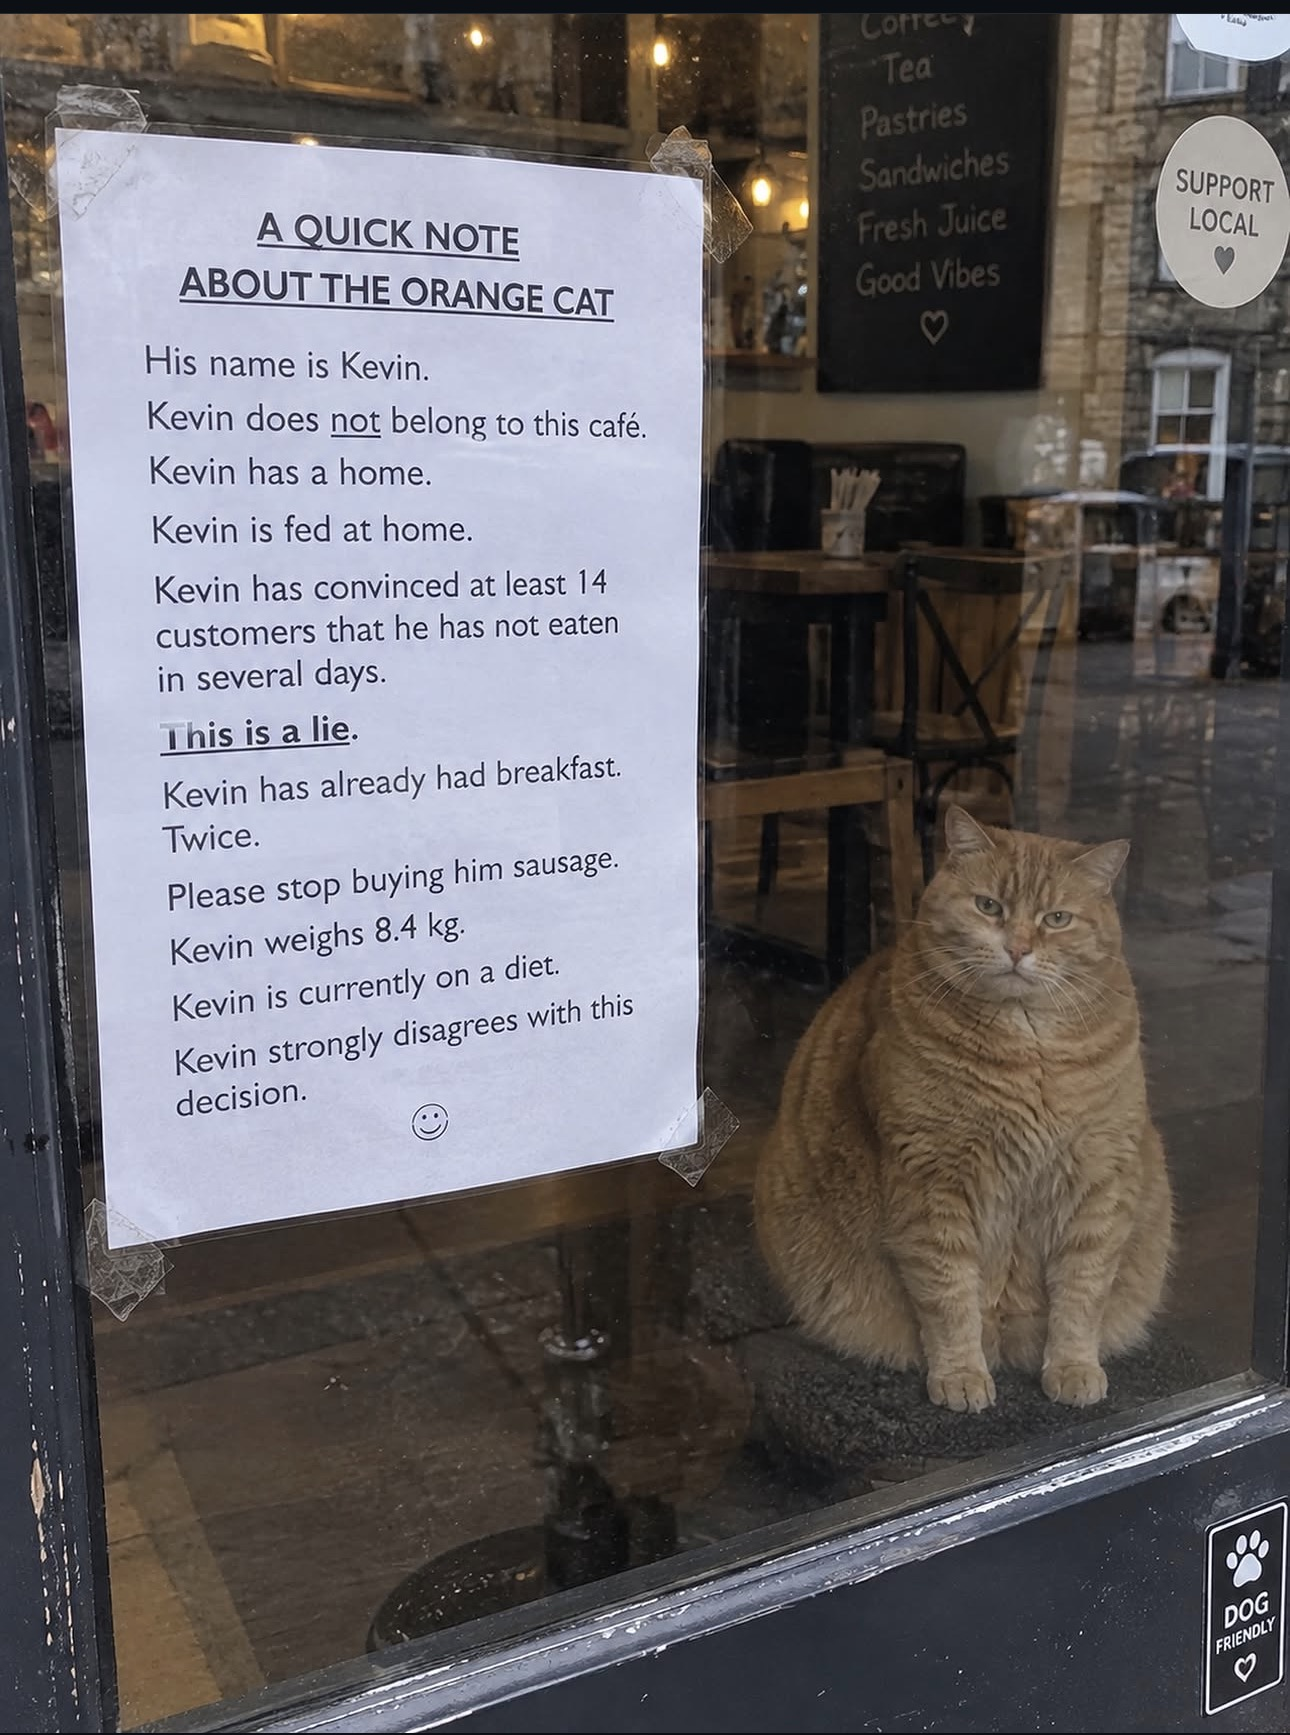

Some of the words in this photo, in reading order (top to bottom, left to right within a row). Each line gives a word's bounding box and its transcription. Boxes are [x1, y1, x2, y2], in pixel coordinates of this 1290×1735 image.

[879, 52, 933, 86] Tea
[860, 102, 968, 141] Pastries
[859, 147, 1010, 192] Sandwiches
[1176, 168, 1275, 203] SUPPORT
[257, 212, 284, 242] A
[297, 214, 414, 251] QUICK
[426, 221, 519, 256] NOTE
[857, 207, 928, 245] Fresh
[937, 202, 1008, 238] Juice
[1190, 206, 1259, 237] LOCAL
[179, 267, 312, 301] ABOUT
[320, 273, 390, 305] THE
[401, 277, 543, 313] ORANGE
[553, 286, 614, 316] CAT
[856, 261, 921, 298] Good
[930, 258, 1000, 291] Vibes
[146, 345, 196, 375] His
[210, 356, 295, 377] name
[308, 351, 329, 379] is
[342, 351, 428, 381] Kevin.
[148, 401, 233, 431] Kevin
[247, 403, 319, 432] does
[332, 411, 381, 433] not
[392, 406, 486, 442] belong
[496, 414, 524, 435] to
[533, 410, 579, 437] this
[589, 412, 646, 438] café.
[150, 456, 235, 485] Kevin
[249, 457, 299, 485] has
[311, 466, 328, 485] a
[340, 457, 431, 485] home.
[153, 515, 237, 544] Kevin
[251, 516, 272, 543] is
[284, 514, 330, 542] fed
[344, 520, 372, 542] at
[384, 514, 472, 542] home.
[155, 576, 239, 604] Kevin
[253, 574, 302, 602] has
[314, 571, 458, 600] convinced
[470, 576, 496, 597] at
[507, 570, 566, 596] least
[579, 569, 607, 594] 14
[156, 625, 315, 648] customers
[326, 615, 385, 643] that
[395, 614, 428, 640] he
[440, 613, 484, 639] has
[496, 616, 539, 637] not
[549, 614, 618, 635] eaten
[159, 666, 184, 692] in
[198, 659, 302, 691] several
[315, 658, 385, 692] days.
[160, 721, 234, 750] This
[246, 719, 273, 745] is
[282, 724, 301, 743] a
[313, 715, 358, 742] lie.
[164, 779, 247, 809] Kevin
[261, 775, 309, 802] has
[321, 766, 426, 800] already
[437, 761, 485, 790] had
[497, 755, 620, 785] breakfast.
[162, 824, 259, 853] Twice.
[168, 882, 265, 911] Please
[277, 878, 340, 904] stop
[353, 865, 444, 899] buying
[455, 859, 502, 884] him
[514, 852, 618, 878] sausage.
[171, 934, 252, 965] Kevin
[264, 921, 363, 957] weighs
[375, 914, 417, 942] 8.4
[429, 912, 464, 943] kg.
[173, 990, 254, 1021] Kevin
[268, 985, 287, 1009] is
[299, 968, 426, 1005] currently
[436, 969, 469, 988] on
[480, 966, 495, 983] a
[505, 955, 559, 980] diet.
[176, 1044, 256, 1076] Kevin
[269, 1026, 383, 1063] strongly
[394, 1014, 518, 1046] disagrees
[527, 999, 581, 1028] with
[590, 994, 633, 1020] this
[177, 1082, 306, 1116] decision.
[1224, 1591, 1269, 1629] DOG
[1216, 1616, 1276, 1655] FRIENDLY
